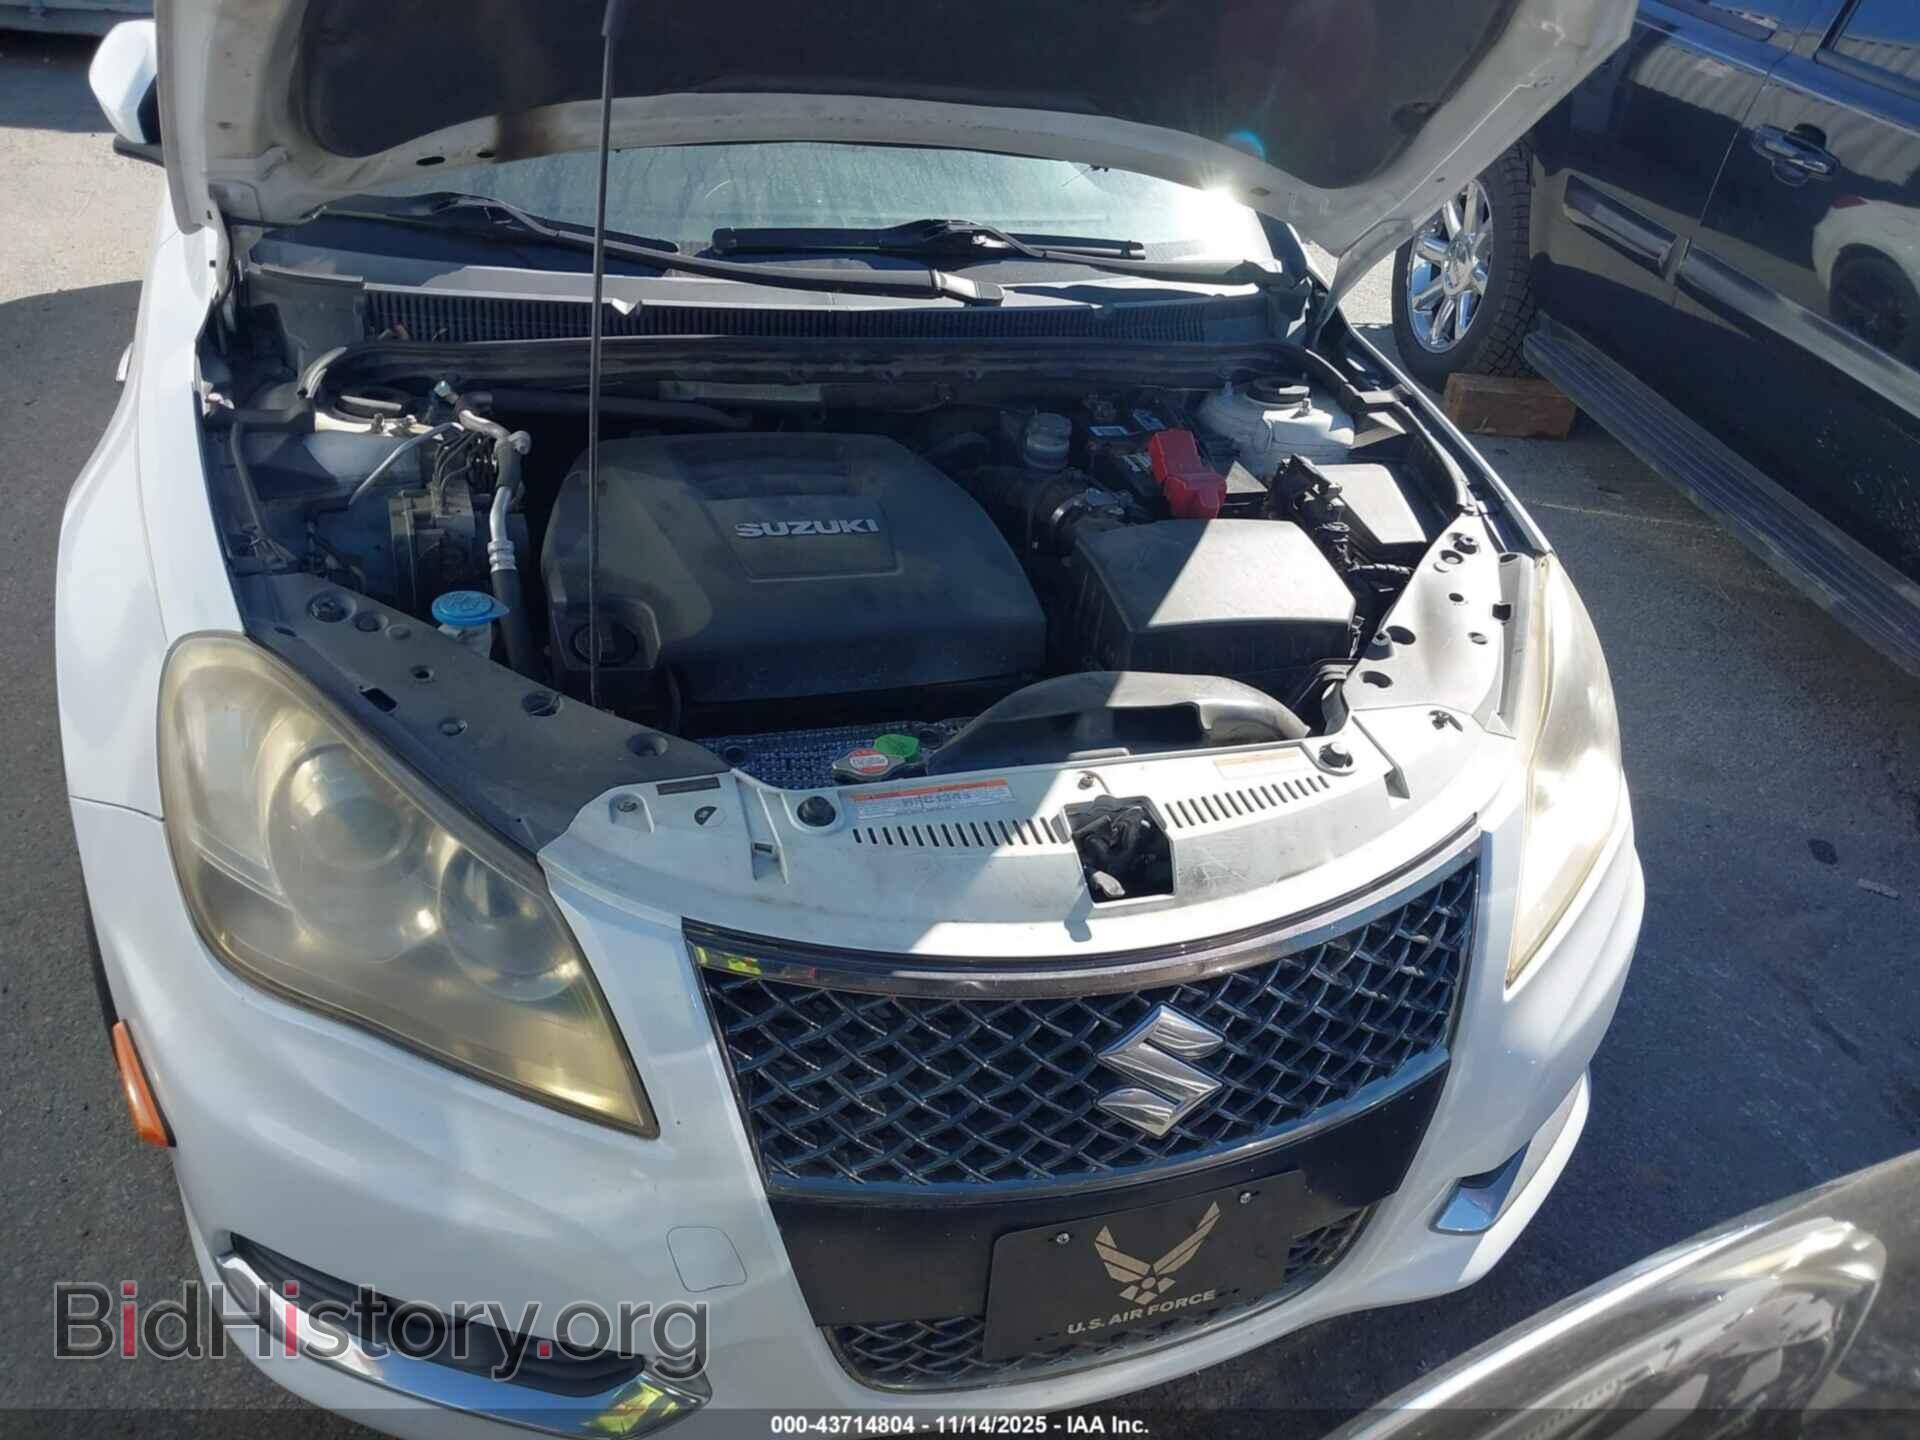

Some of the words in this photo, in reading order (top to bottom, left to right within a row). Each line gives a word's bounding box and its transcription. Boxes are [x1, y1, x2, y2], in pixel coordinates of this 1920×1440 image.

[734, 519, 880, 538] SUZUKI
[1067, 1317, 1105, 1335] U.S.
[1108, 1307, 1143, 1326] AIR
[1147, 1289, 1217, 1317] FORCE
